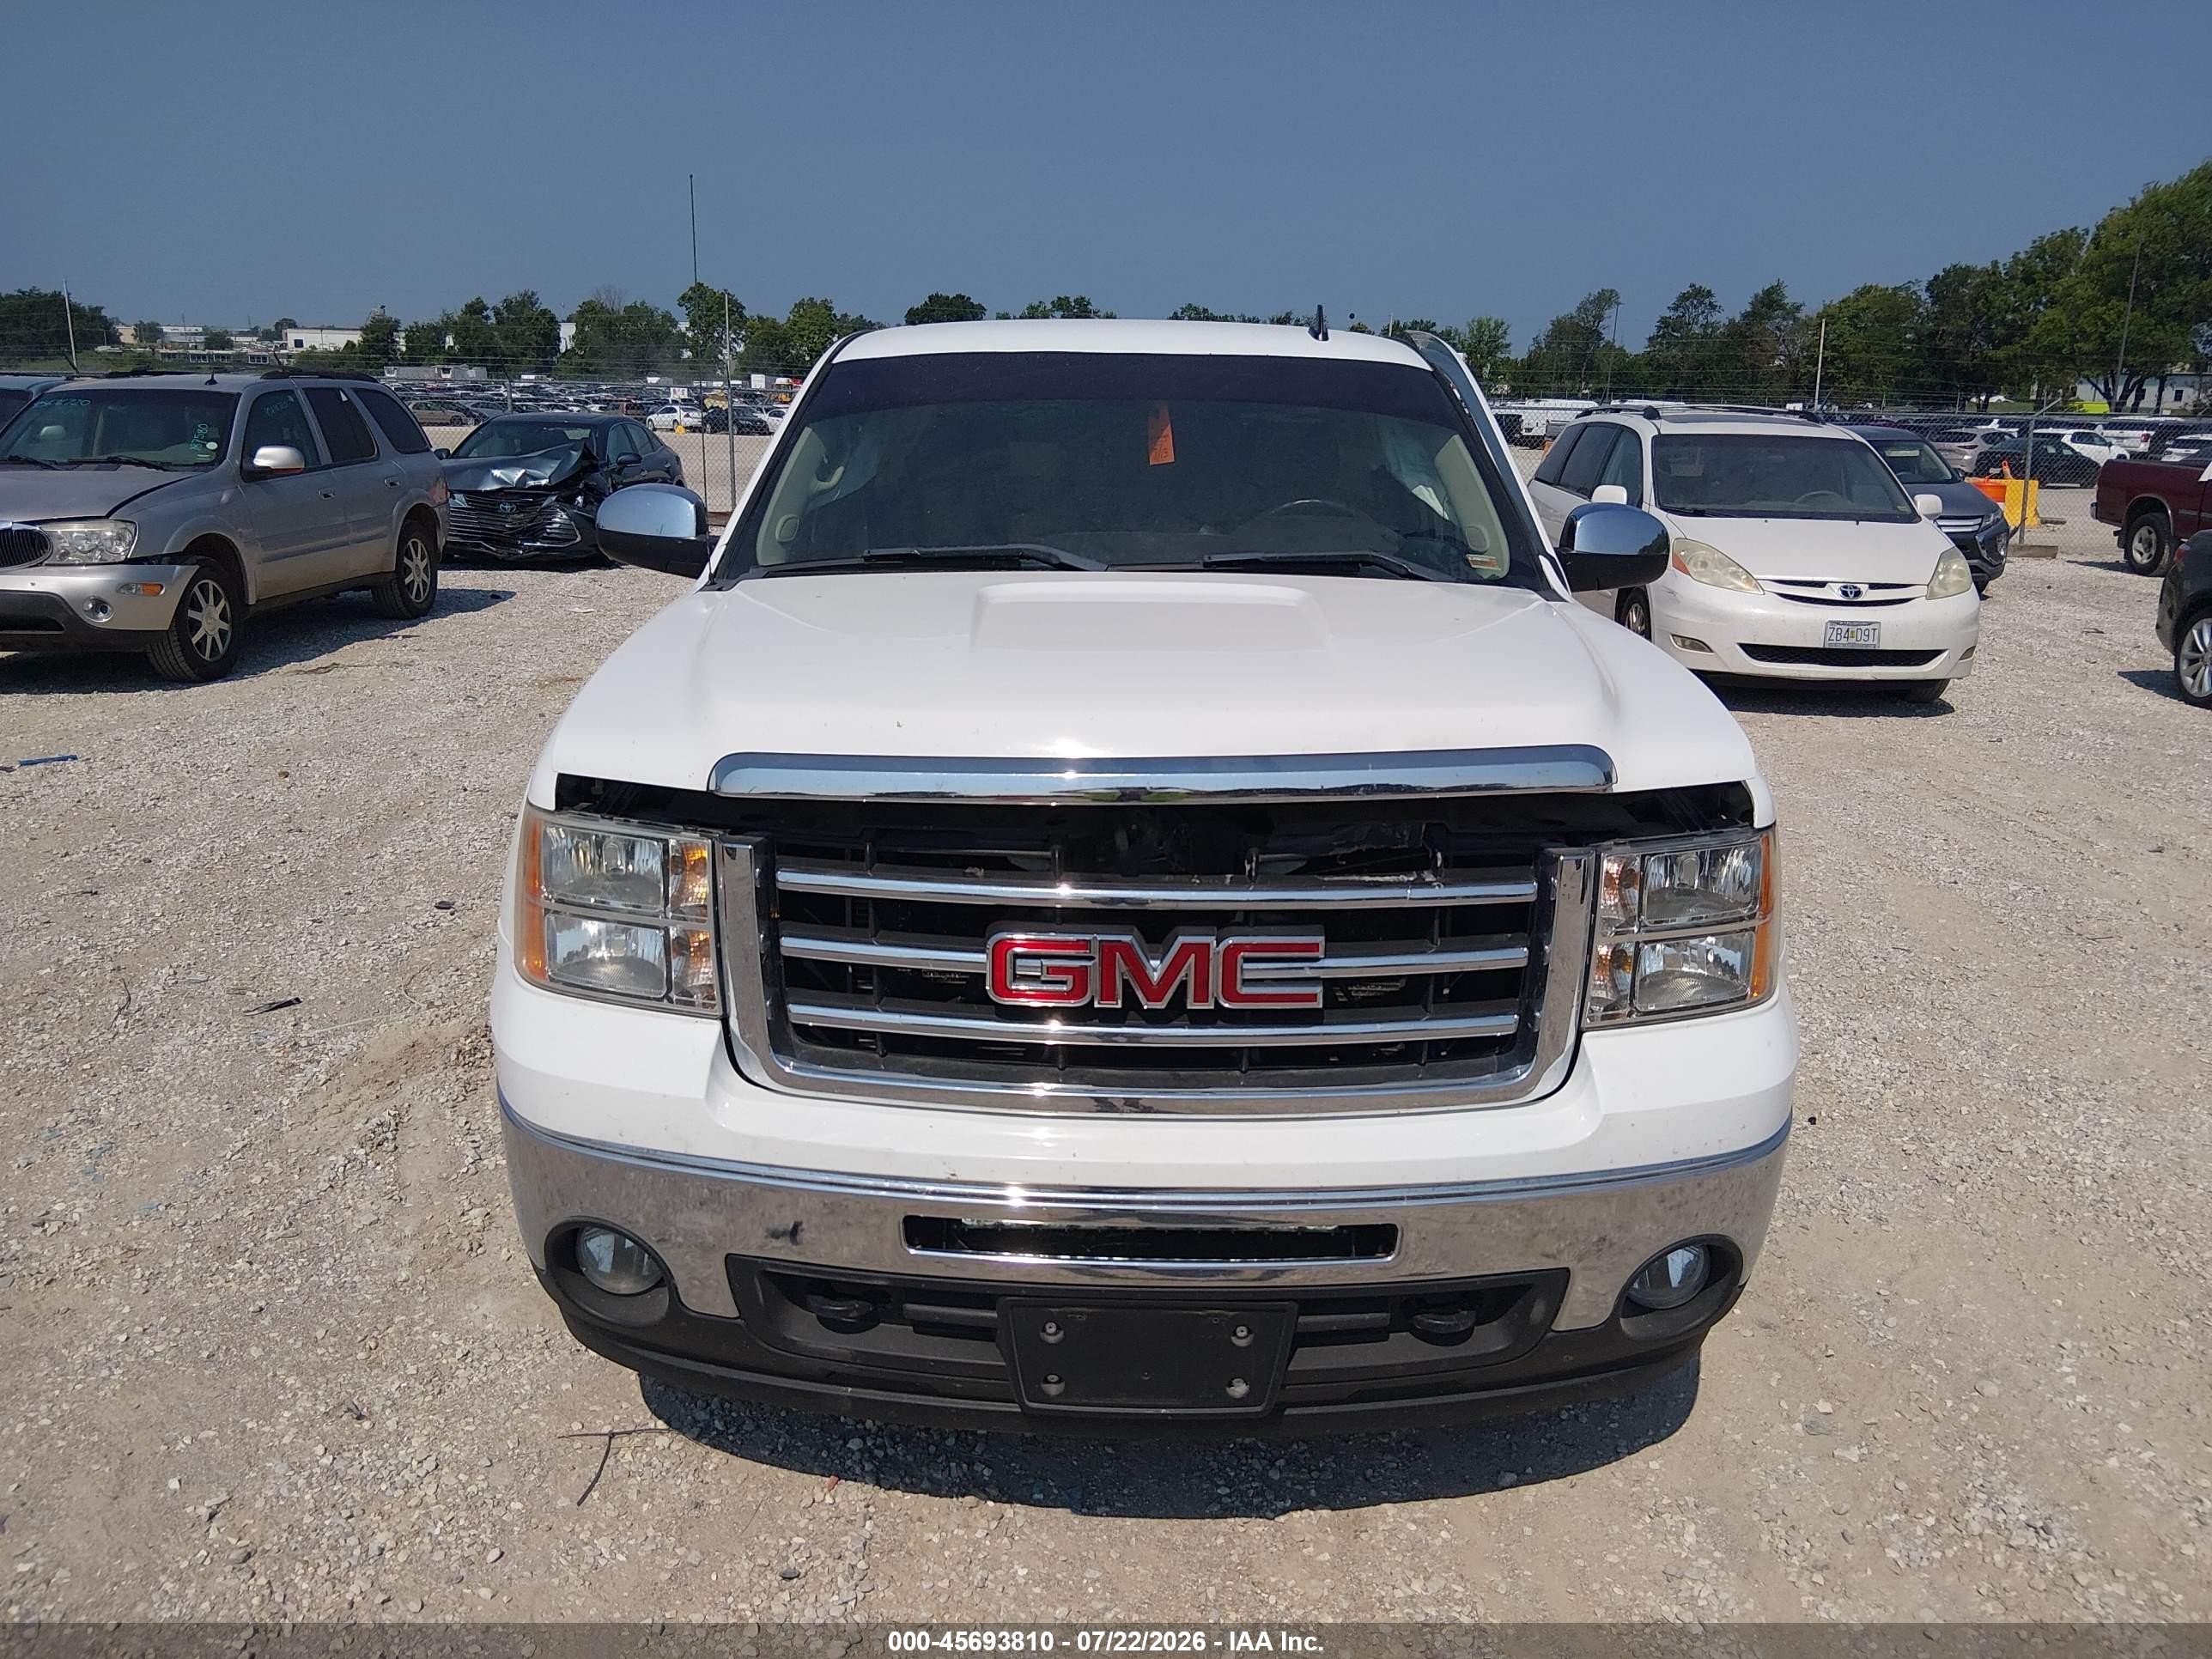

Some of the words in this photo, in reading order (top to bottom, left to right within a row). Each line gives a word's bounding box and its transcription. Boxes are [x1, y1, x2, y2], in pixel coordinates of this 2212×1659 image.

[1828, 627, 1850, 641] ZB4
[1856, 628, 1877, 642] D9T
[987, 932, 1324, 1010] GMC
